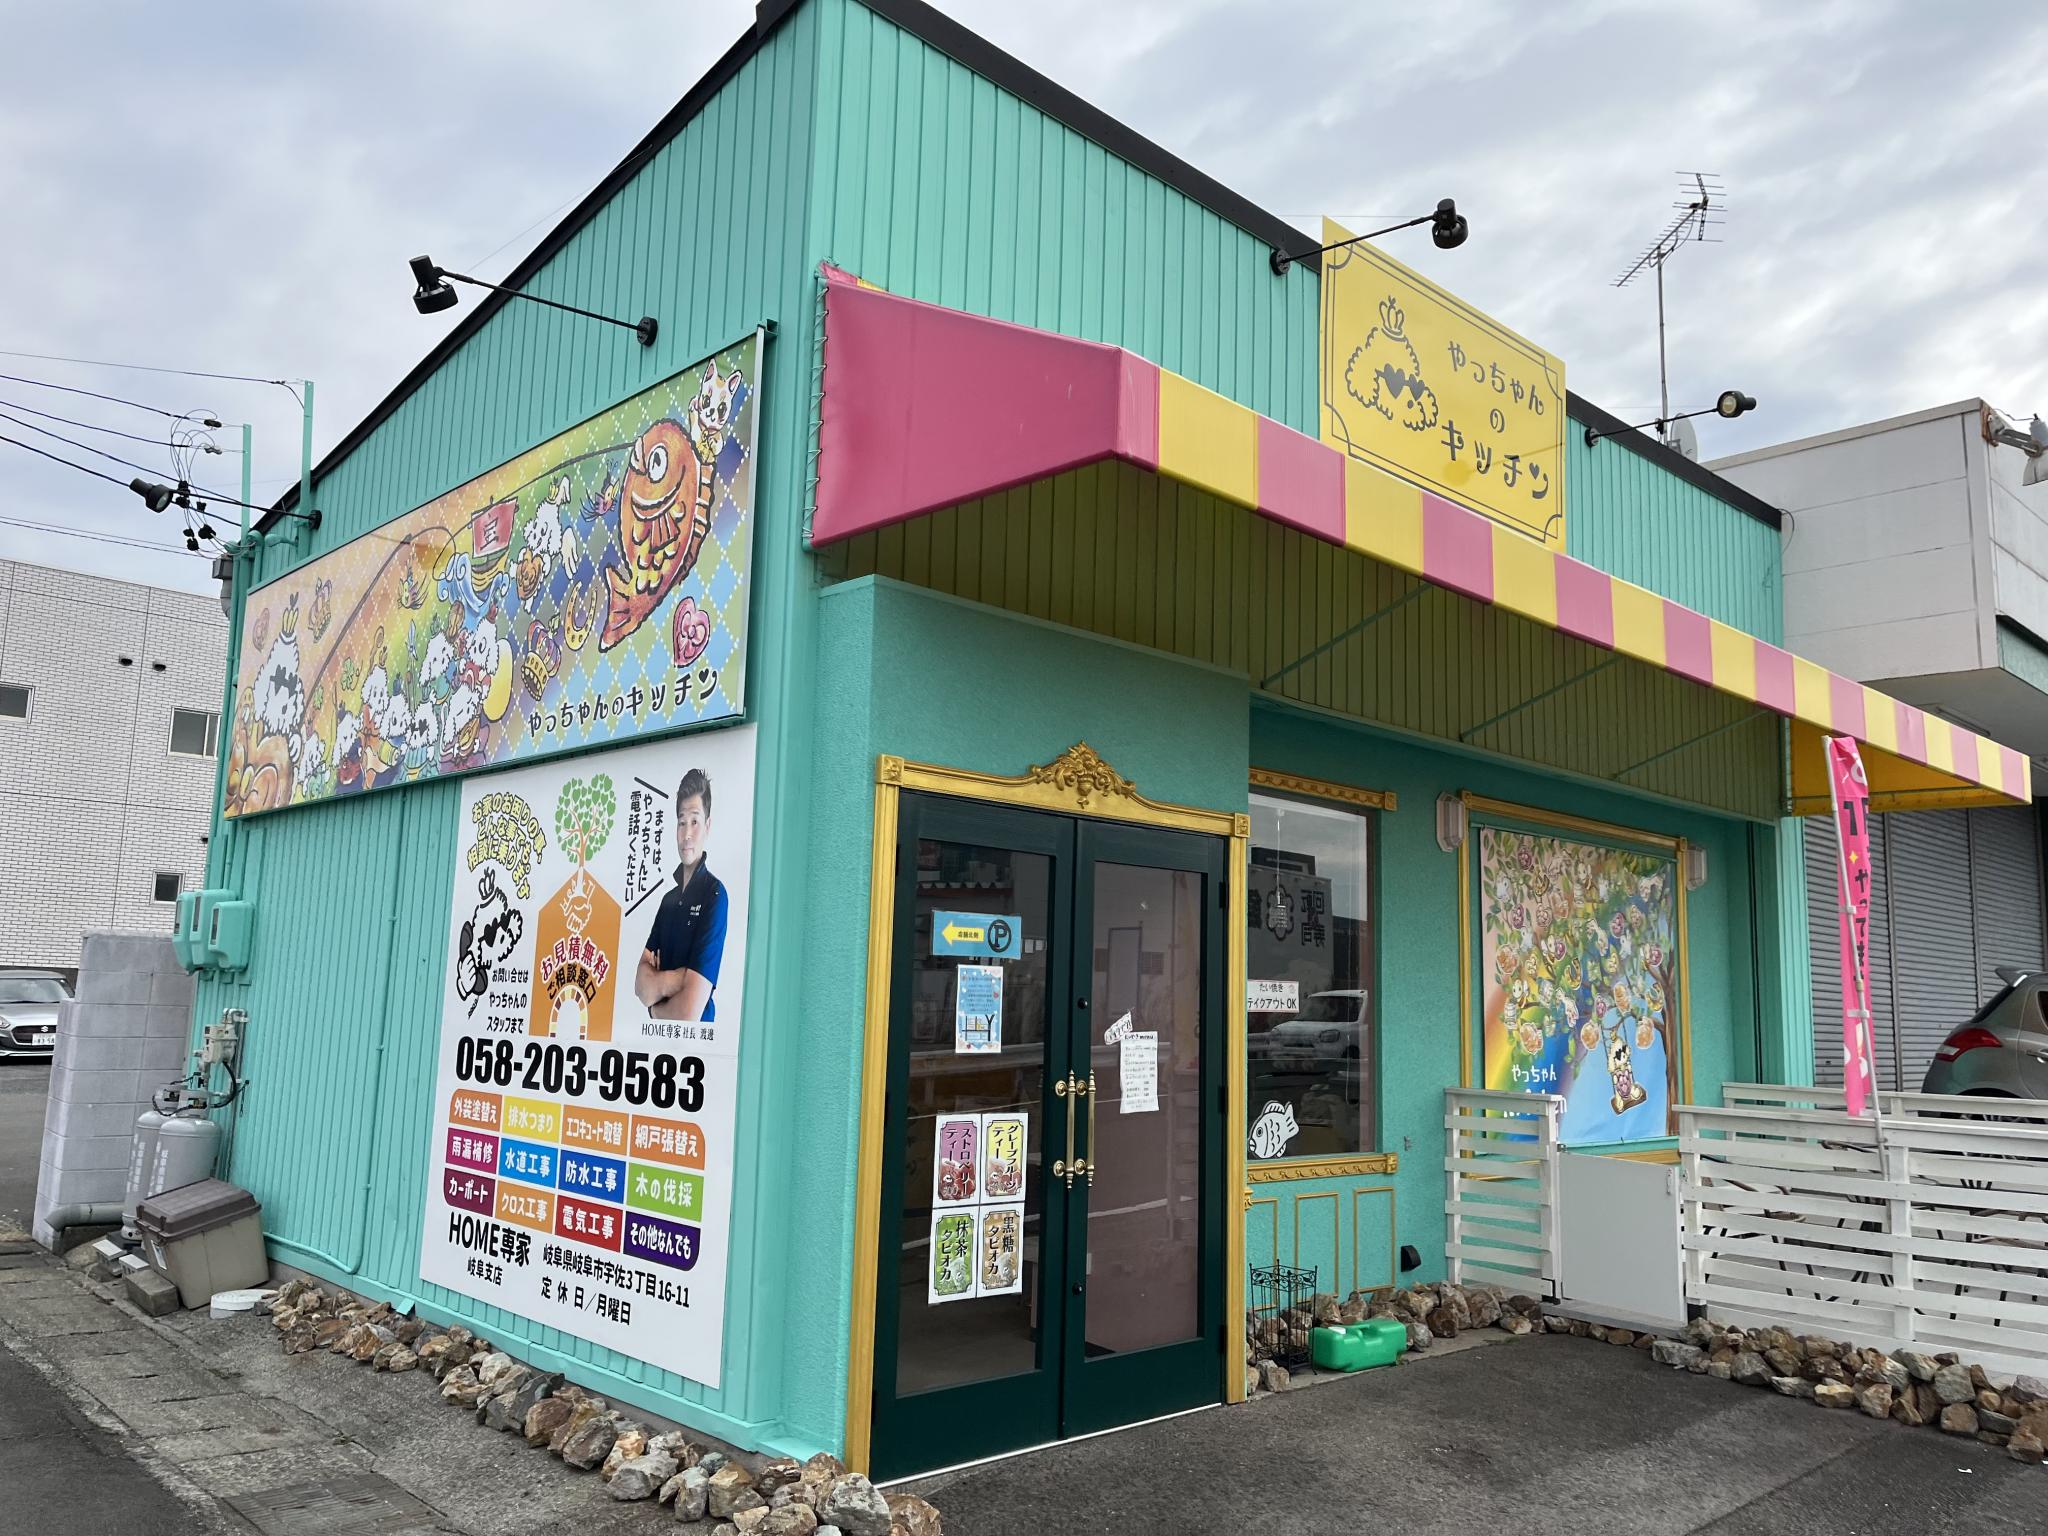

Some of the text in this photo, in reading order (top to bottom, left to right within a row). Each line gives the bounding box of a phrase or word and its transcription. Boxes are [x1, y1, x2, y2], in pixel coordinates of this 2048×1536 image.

[1447, 340, 1545, 416] やっちゃん
[1489, 408, 1505, 434] の
[1440, 419, 1549, 500] キッチン
[527, 667, 718, 738] やっちゃんのキッチン
[625, 790, 642, 902] 電話ください
[638, 793, 653, 893] やっちゃんに
[652, 809, 664, 873] まずは、
[492, 967, 529, 984] お問い合せは
[541, 935, 610, 985] お見積無料
[489, 991, 528, 1009] やっちゃんの
[547, 963, 597, 1004] ご相談窓口
[1259, 983, 1284, 993] たい焼き
[1286, 998, 1297, 1009] OK
[486, 1015, 524, 1034] スタッフまで
[641, 1023, 682, 1040] HOME専家
[682, 1025, 696, 1040] 社長
[455, 1035, 706, 1114] 058-203-9583
[1511, 1063, 1557, 1083] やっちゃん
[453, 1097, 497, 1124] 外装塗替え
[507, 1104, 554, 1134] 排水つまり
[566, 1117, 623, 1146] エコキュート取替
[634, 1123, 699, 1158] 網戸張替え
[946, 1128, 958, 1162] ティー
[992, 1127, 1005, 1160] ティー
[451, 1135, 494, 1164] 雨漏補修
[504, 1147, 551, 1178] 水道工事
[958, 1128, 972, 1196] ストロベリー
[1005, 1125, 1019, 1191] グレープフルーツ
[448, 1176, 489, 1204] カーポート
[564, 1159, 618, 1193] 防水工事
[635, 1171, 693, 1208] 木の伐採
[501, 1192, 548, 1222] クロス工事
[562, 1205, 615, 1240] 電気工事
[448, 1211, 532, 1268] HOME専家
[630, 1222, 692, 1260] その他なんでも
[955, 1220, 969, 1258] 抹茶
[987, 1225, 1000, 1275] タピオカ
[1002, 1216, 1015, 1253] 黒糖
[467, 1256, 503, 1287] 岐阜支店
[940, 1229, 953, 1282] タピオカ
